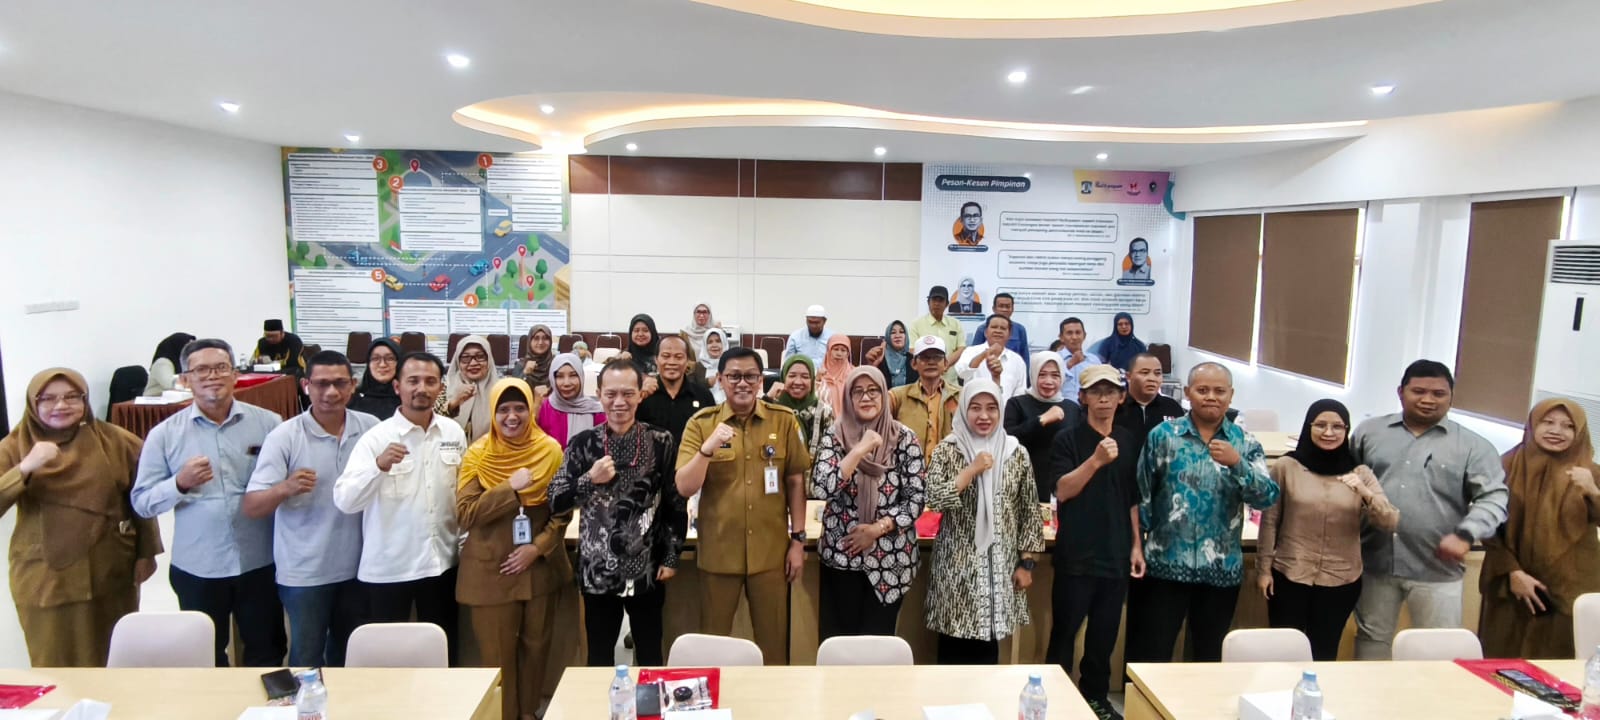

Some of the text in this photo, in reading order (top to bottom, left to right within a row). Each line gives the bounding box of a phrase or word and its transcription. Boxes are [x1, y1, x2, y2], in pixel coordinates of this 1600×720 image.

[376, 160, 384, 170] 3
[482, 156, 488, 166] 1
[392, 177, 400, 187] 2
[941, 178, 1026, 188] Pesan-Kesan Pimpinan
[374, 270, 383, 280] 5
